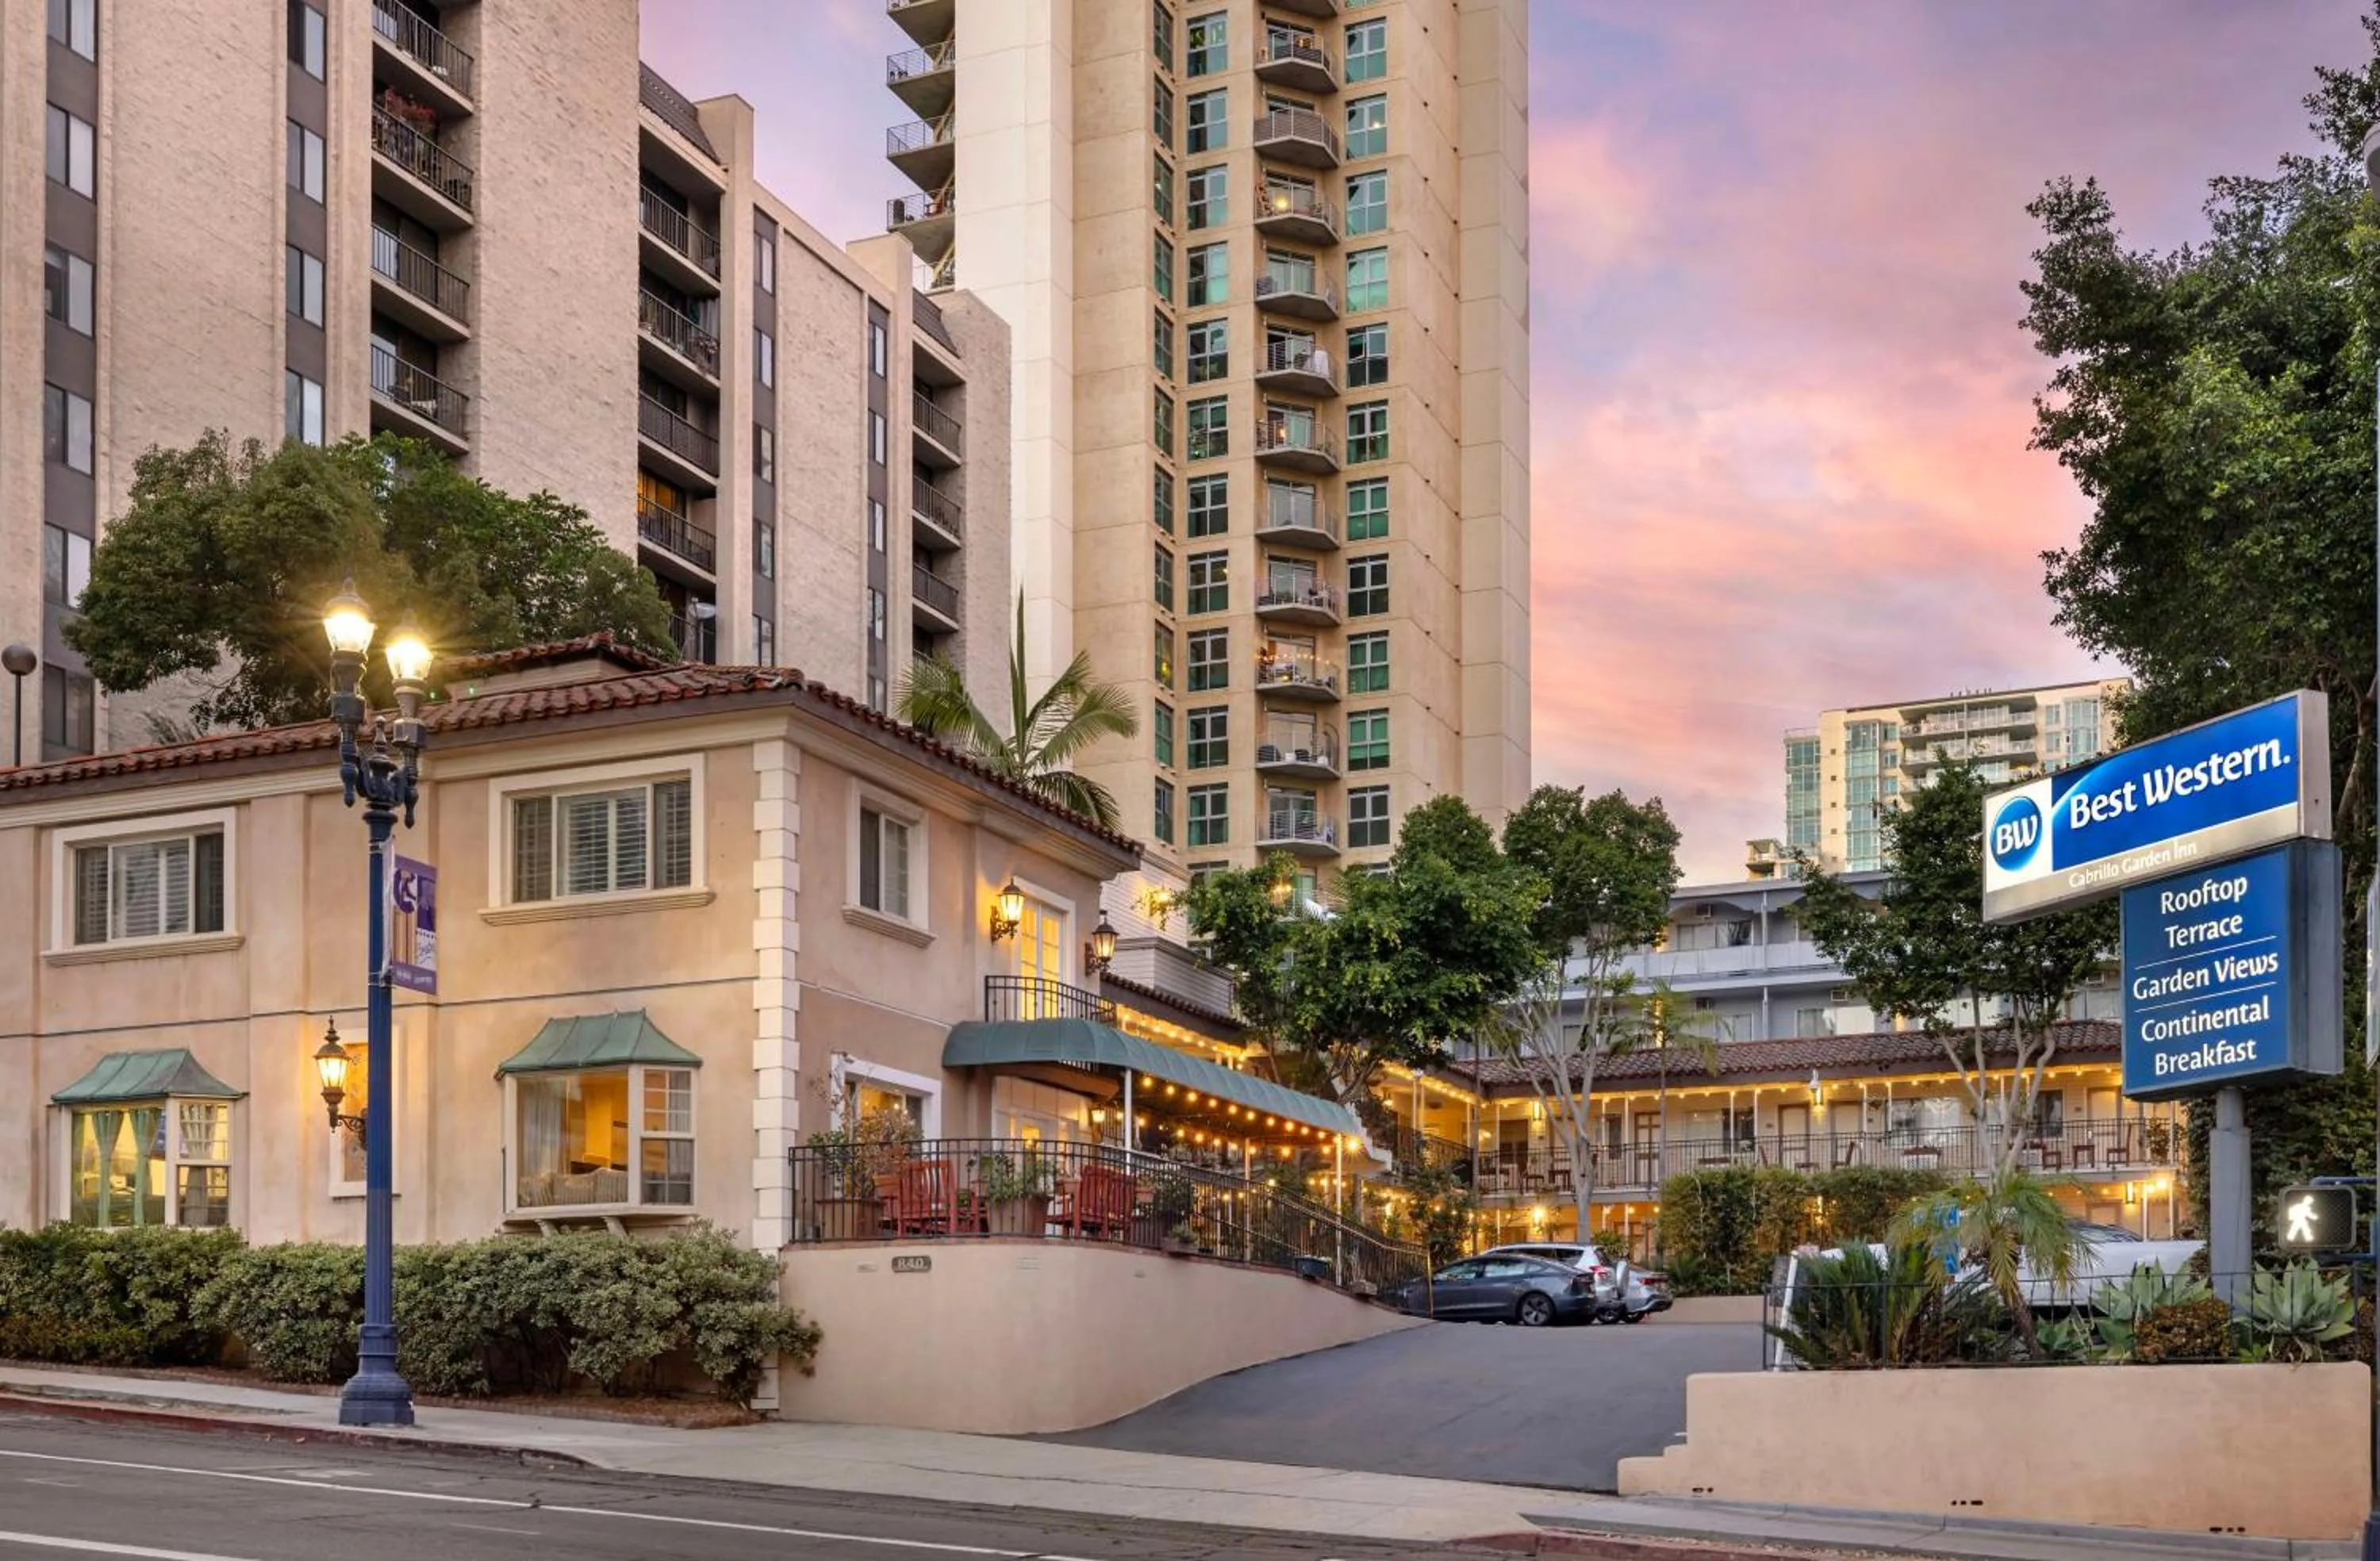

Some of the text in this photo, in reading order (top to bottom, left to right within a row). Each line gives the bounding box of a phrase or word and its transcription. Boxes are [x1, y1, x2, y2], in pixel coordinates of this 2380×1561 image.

[2070, 738, 2291, 830] Best Western.
[1996, 814, 2038, 856] BW
[2068, 839, 2198, 888] Cabrillo Garden Inn
[2160, 876, 2248, 915] Rooftop
[2164, 914, 2244, 949] Terrace
[2132, 952, 2279, 1001] Garden Views
[2141, 993, 2271, 1042] Continental
[2155, 1037, 2258, 1076] Breakfast
